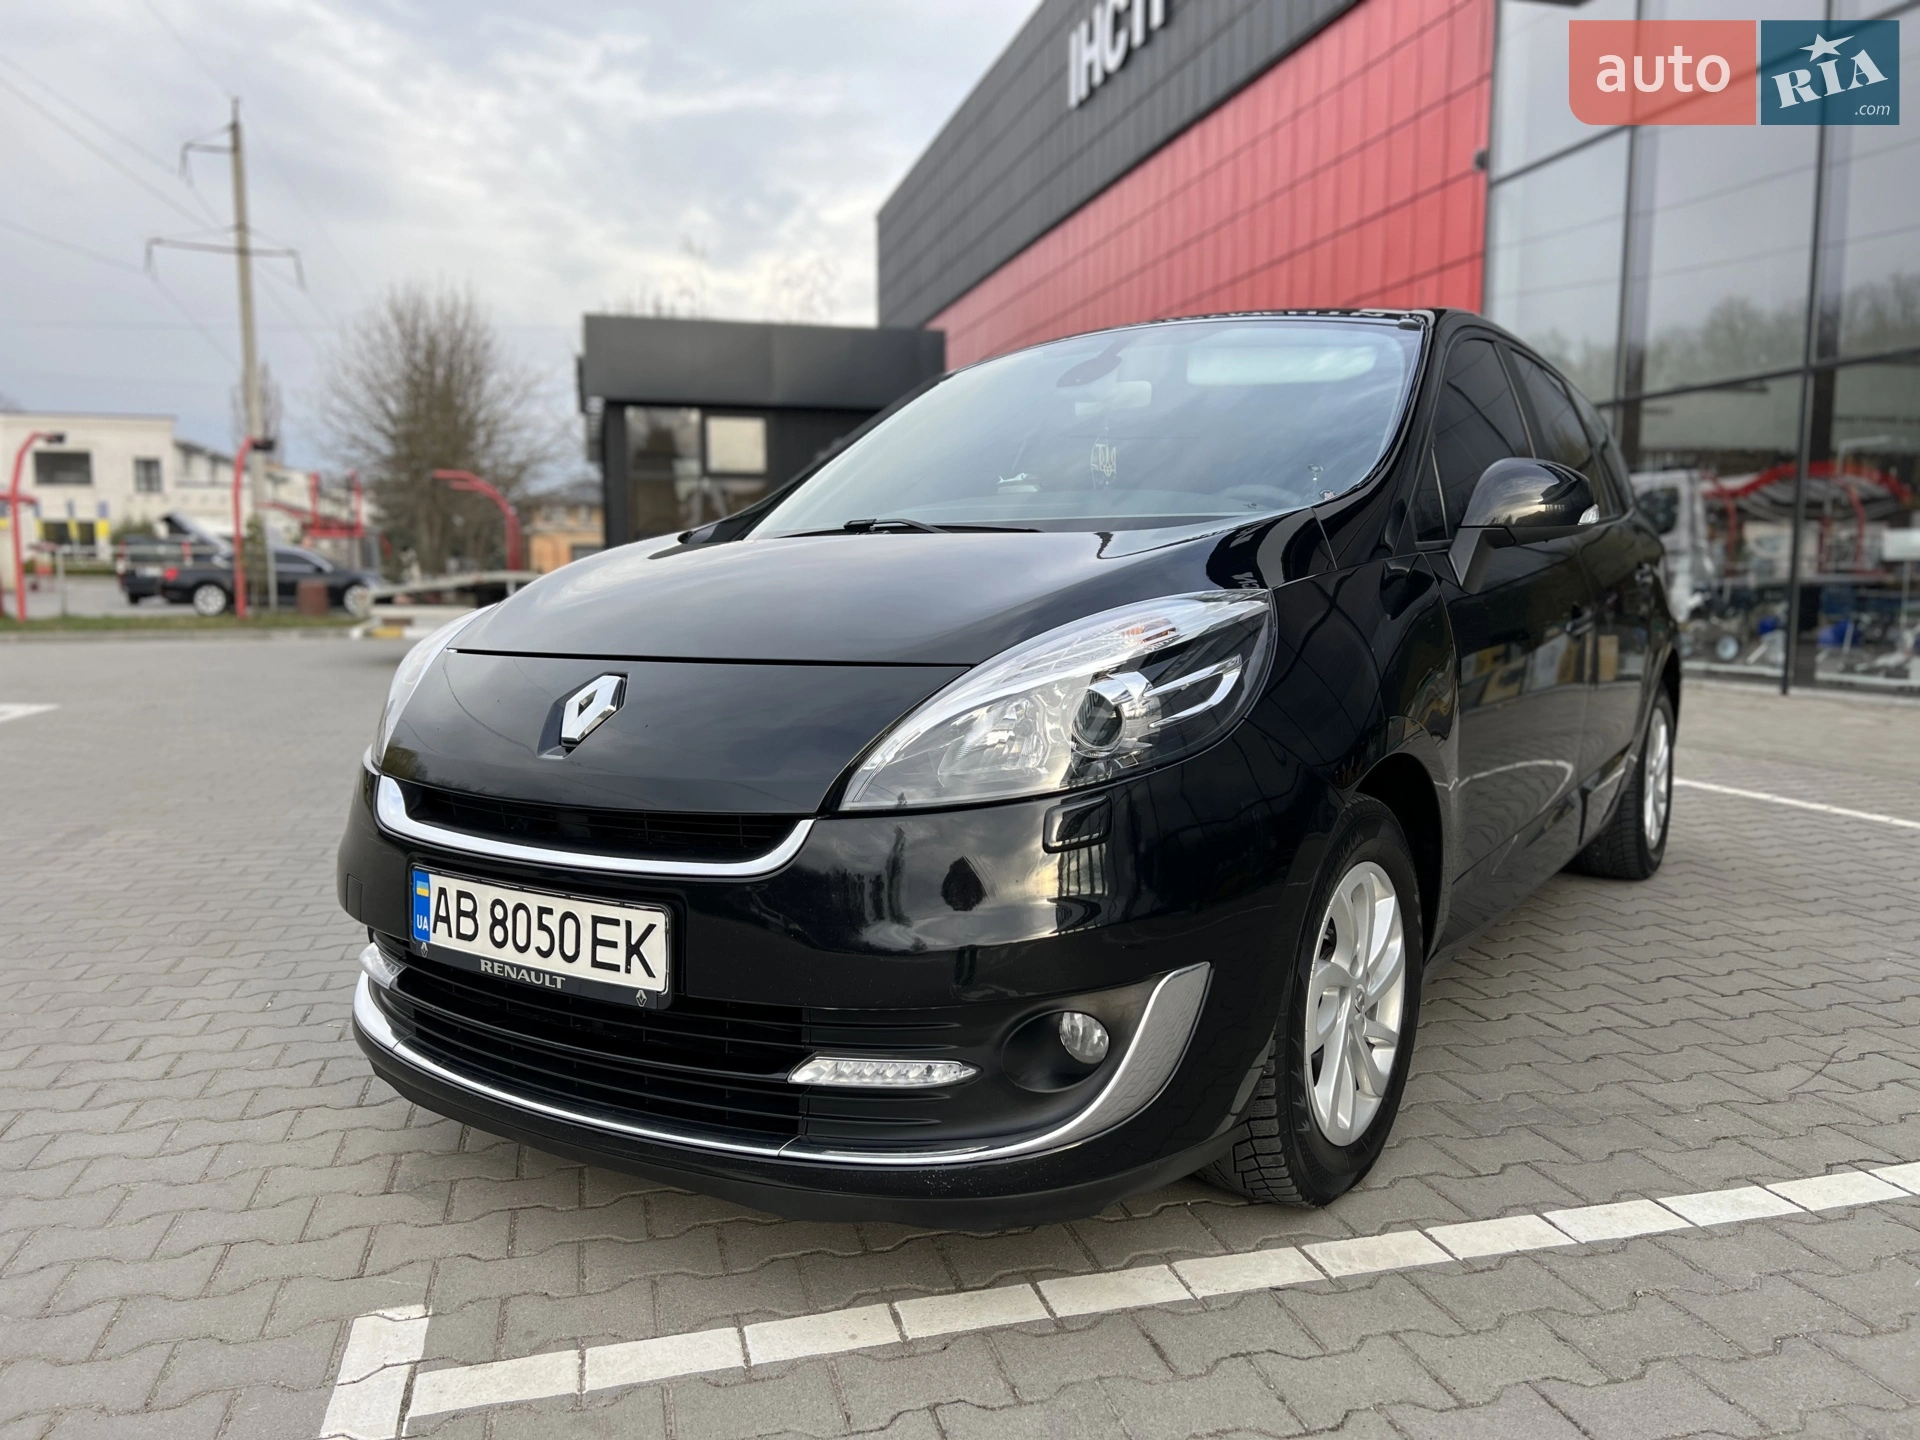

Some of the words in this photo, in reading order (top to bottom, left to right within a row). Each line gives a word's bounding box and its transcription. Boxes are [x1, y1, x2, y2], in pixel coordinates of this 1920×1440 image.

[416, 914, 429, 932] UA
[432, 886, 479, 942] AB
[489, 898, 581, 964] 8050
[590, 915, 657, 979] EK
[479, 958, 566, 990] RENAULT
